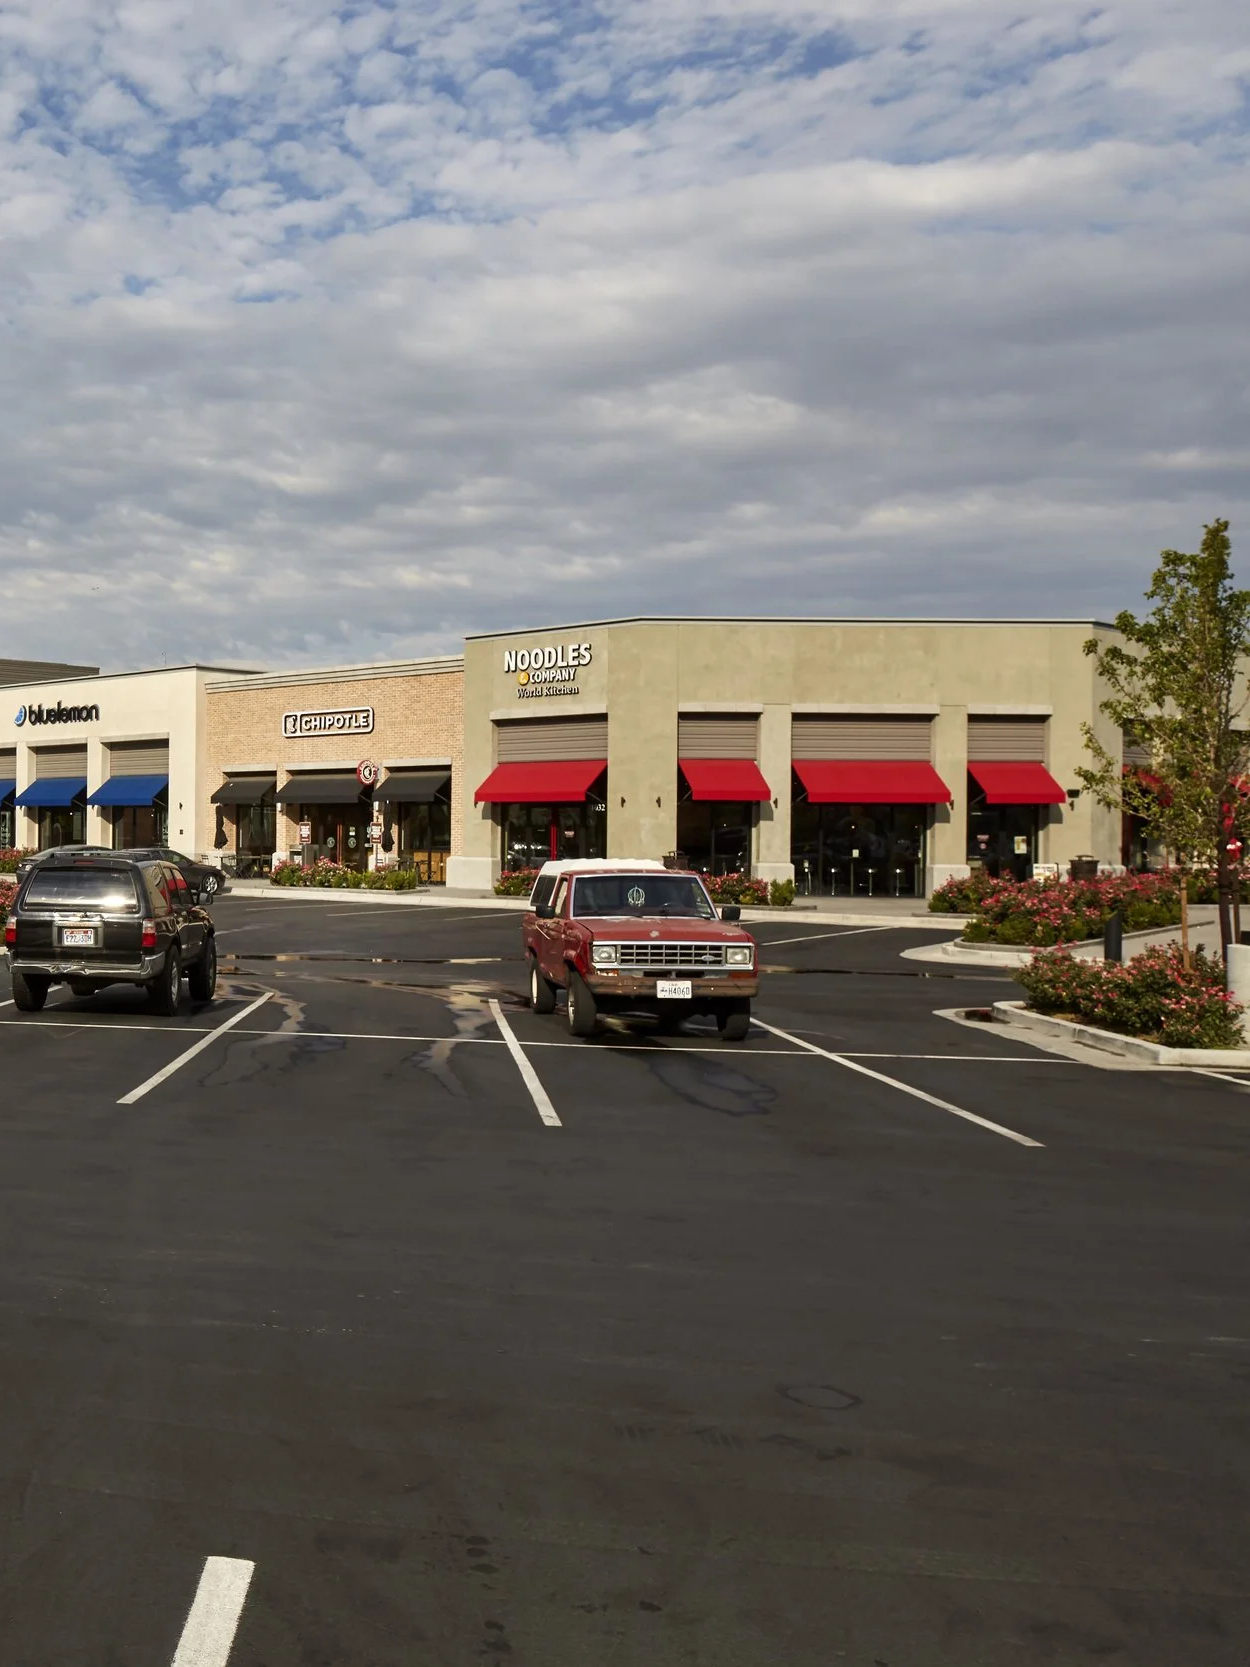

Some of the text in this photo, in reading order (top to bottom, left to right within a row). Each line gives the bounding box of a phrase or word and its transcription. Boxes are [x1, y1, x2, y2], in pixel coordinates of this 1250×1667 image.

[504, 643, 592, 672] NOODLES
[530, 668, 576, 683] COMPANY
[518, 685, 579, 698] World Kitchen
[28, 700, 99, 726] bluelemon
[302, 713, 369, 731] CHIPOTLE
